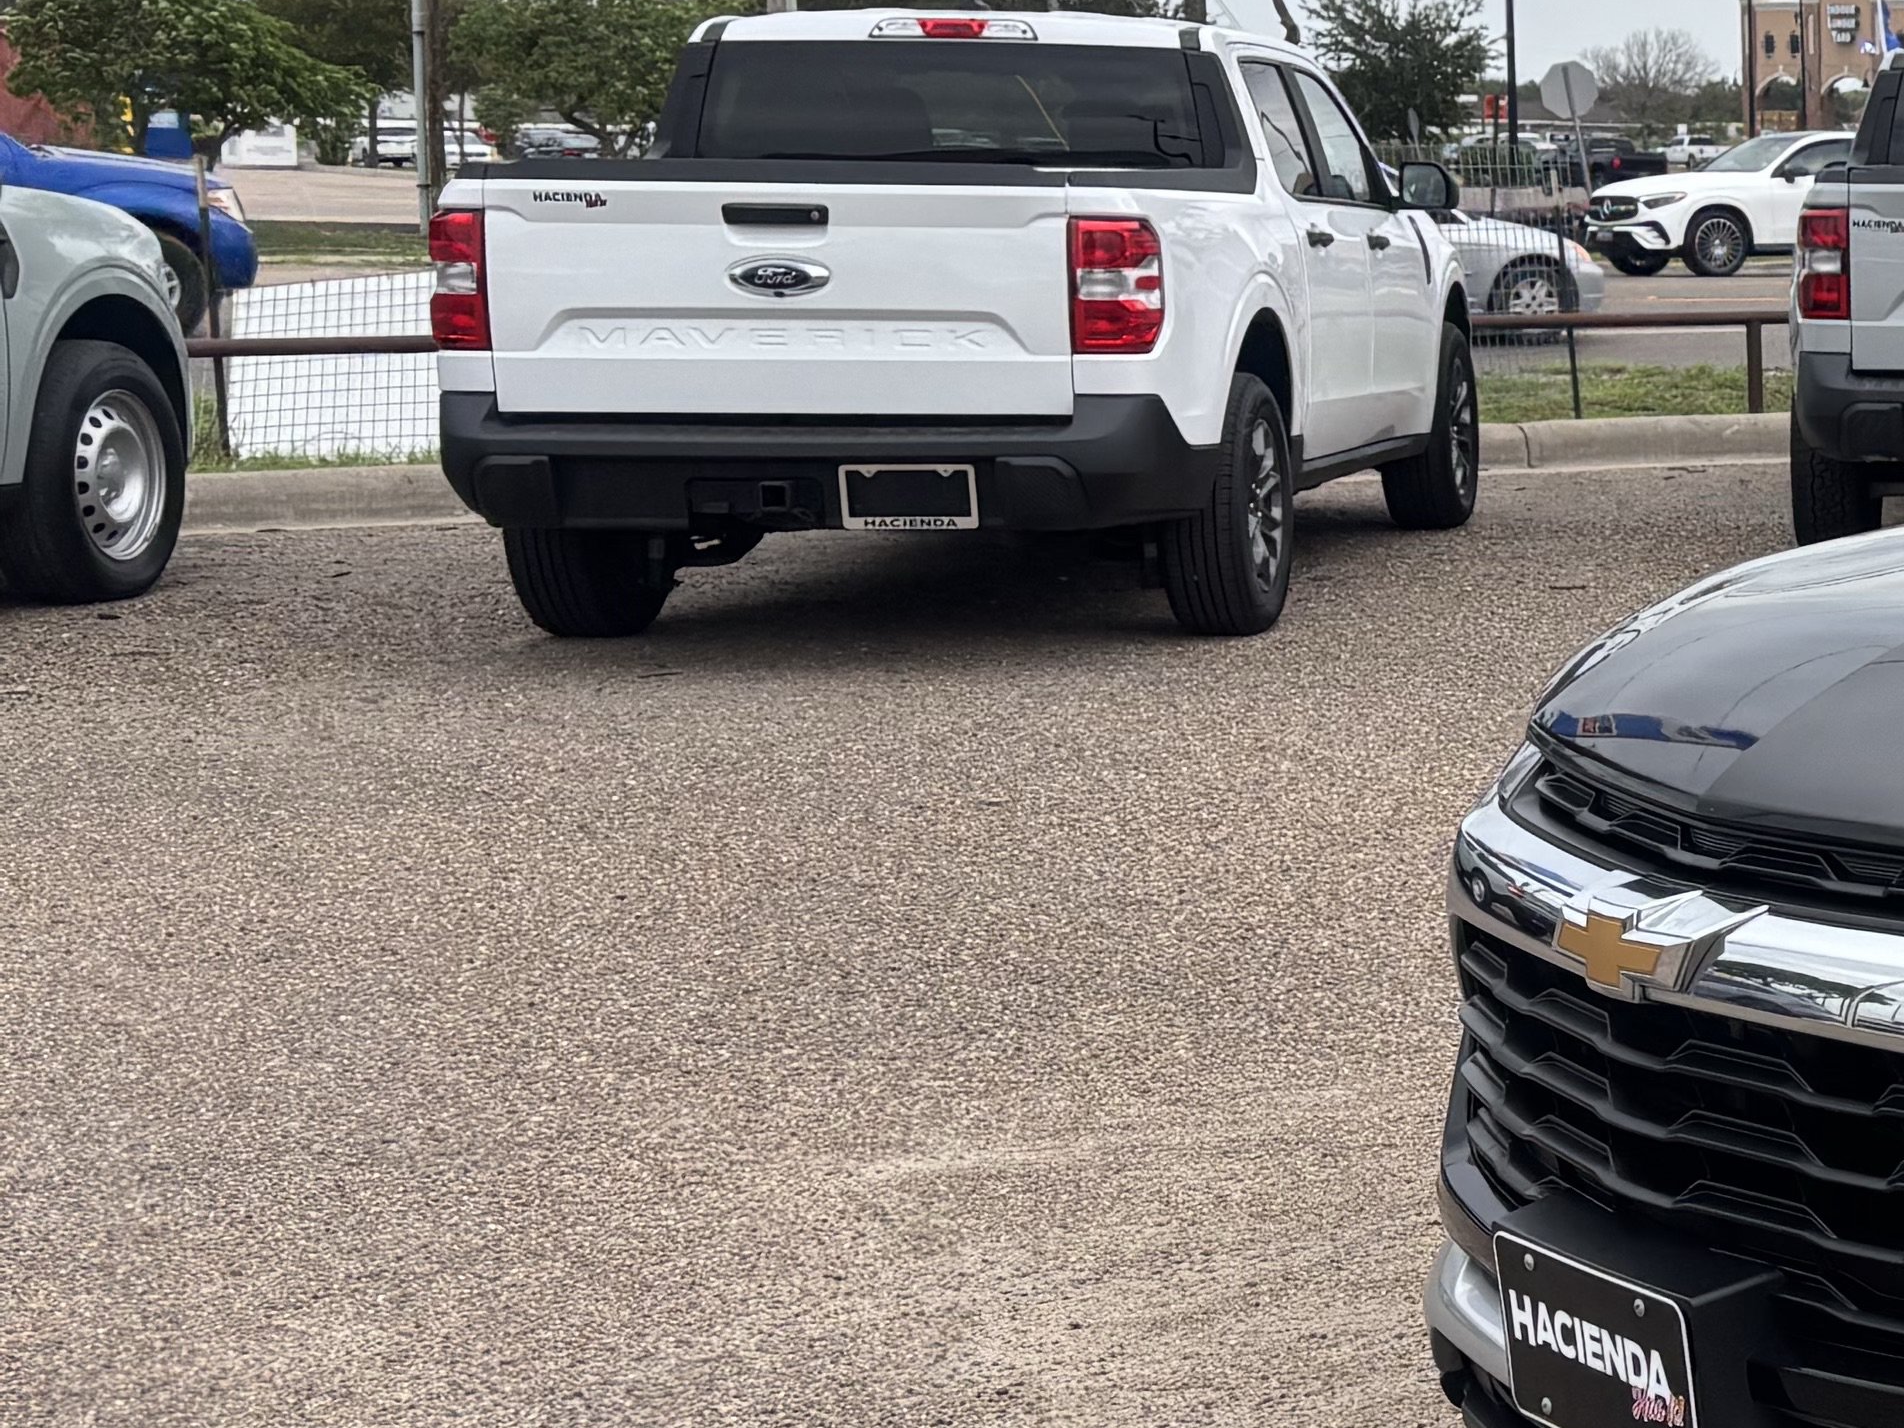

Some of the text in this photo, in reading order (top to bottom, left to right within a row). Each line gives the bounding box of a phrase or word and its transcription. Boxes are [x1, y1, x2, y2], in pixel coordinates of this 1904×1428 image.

[754, 267, 796, 284] Ford
[580, 326, 988, 350] MAVERICK
[864, 518, 958, 528] HACIENDA
[1508, 1288, 1673, 1403] HACIENDA
